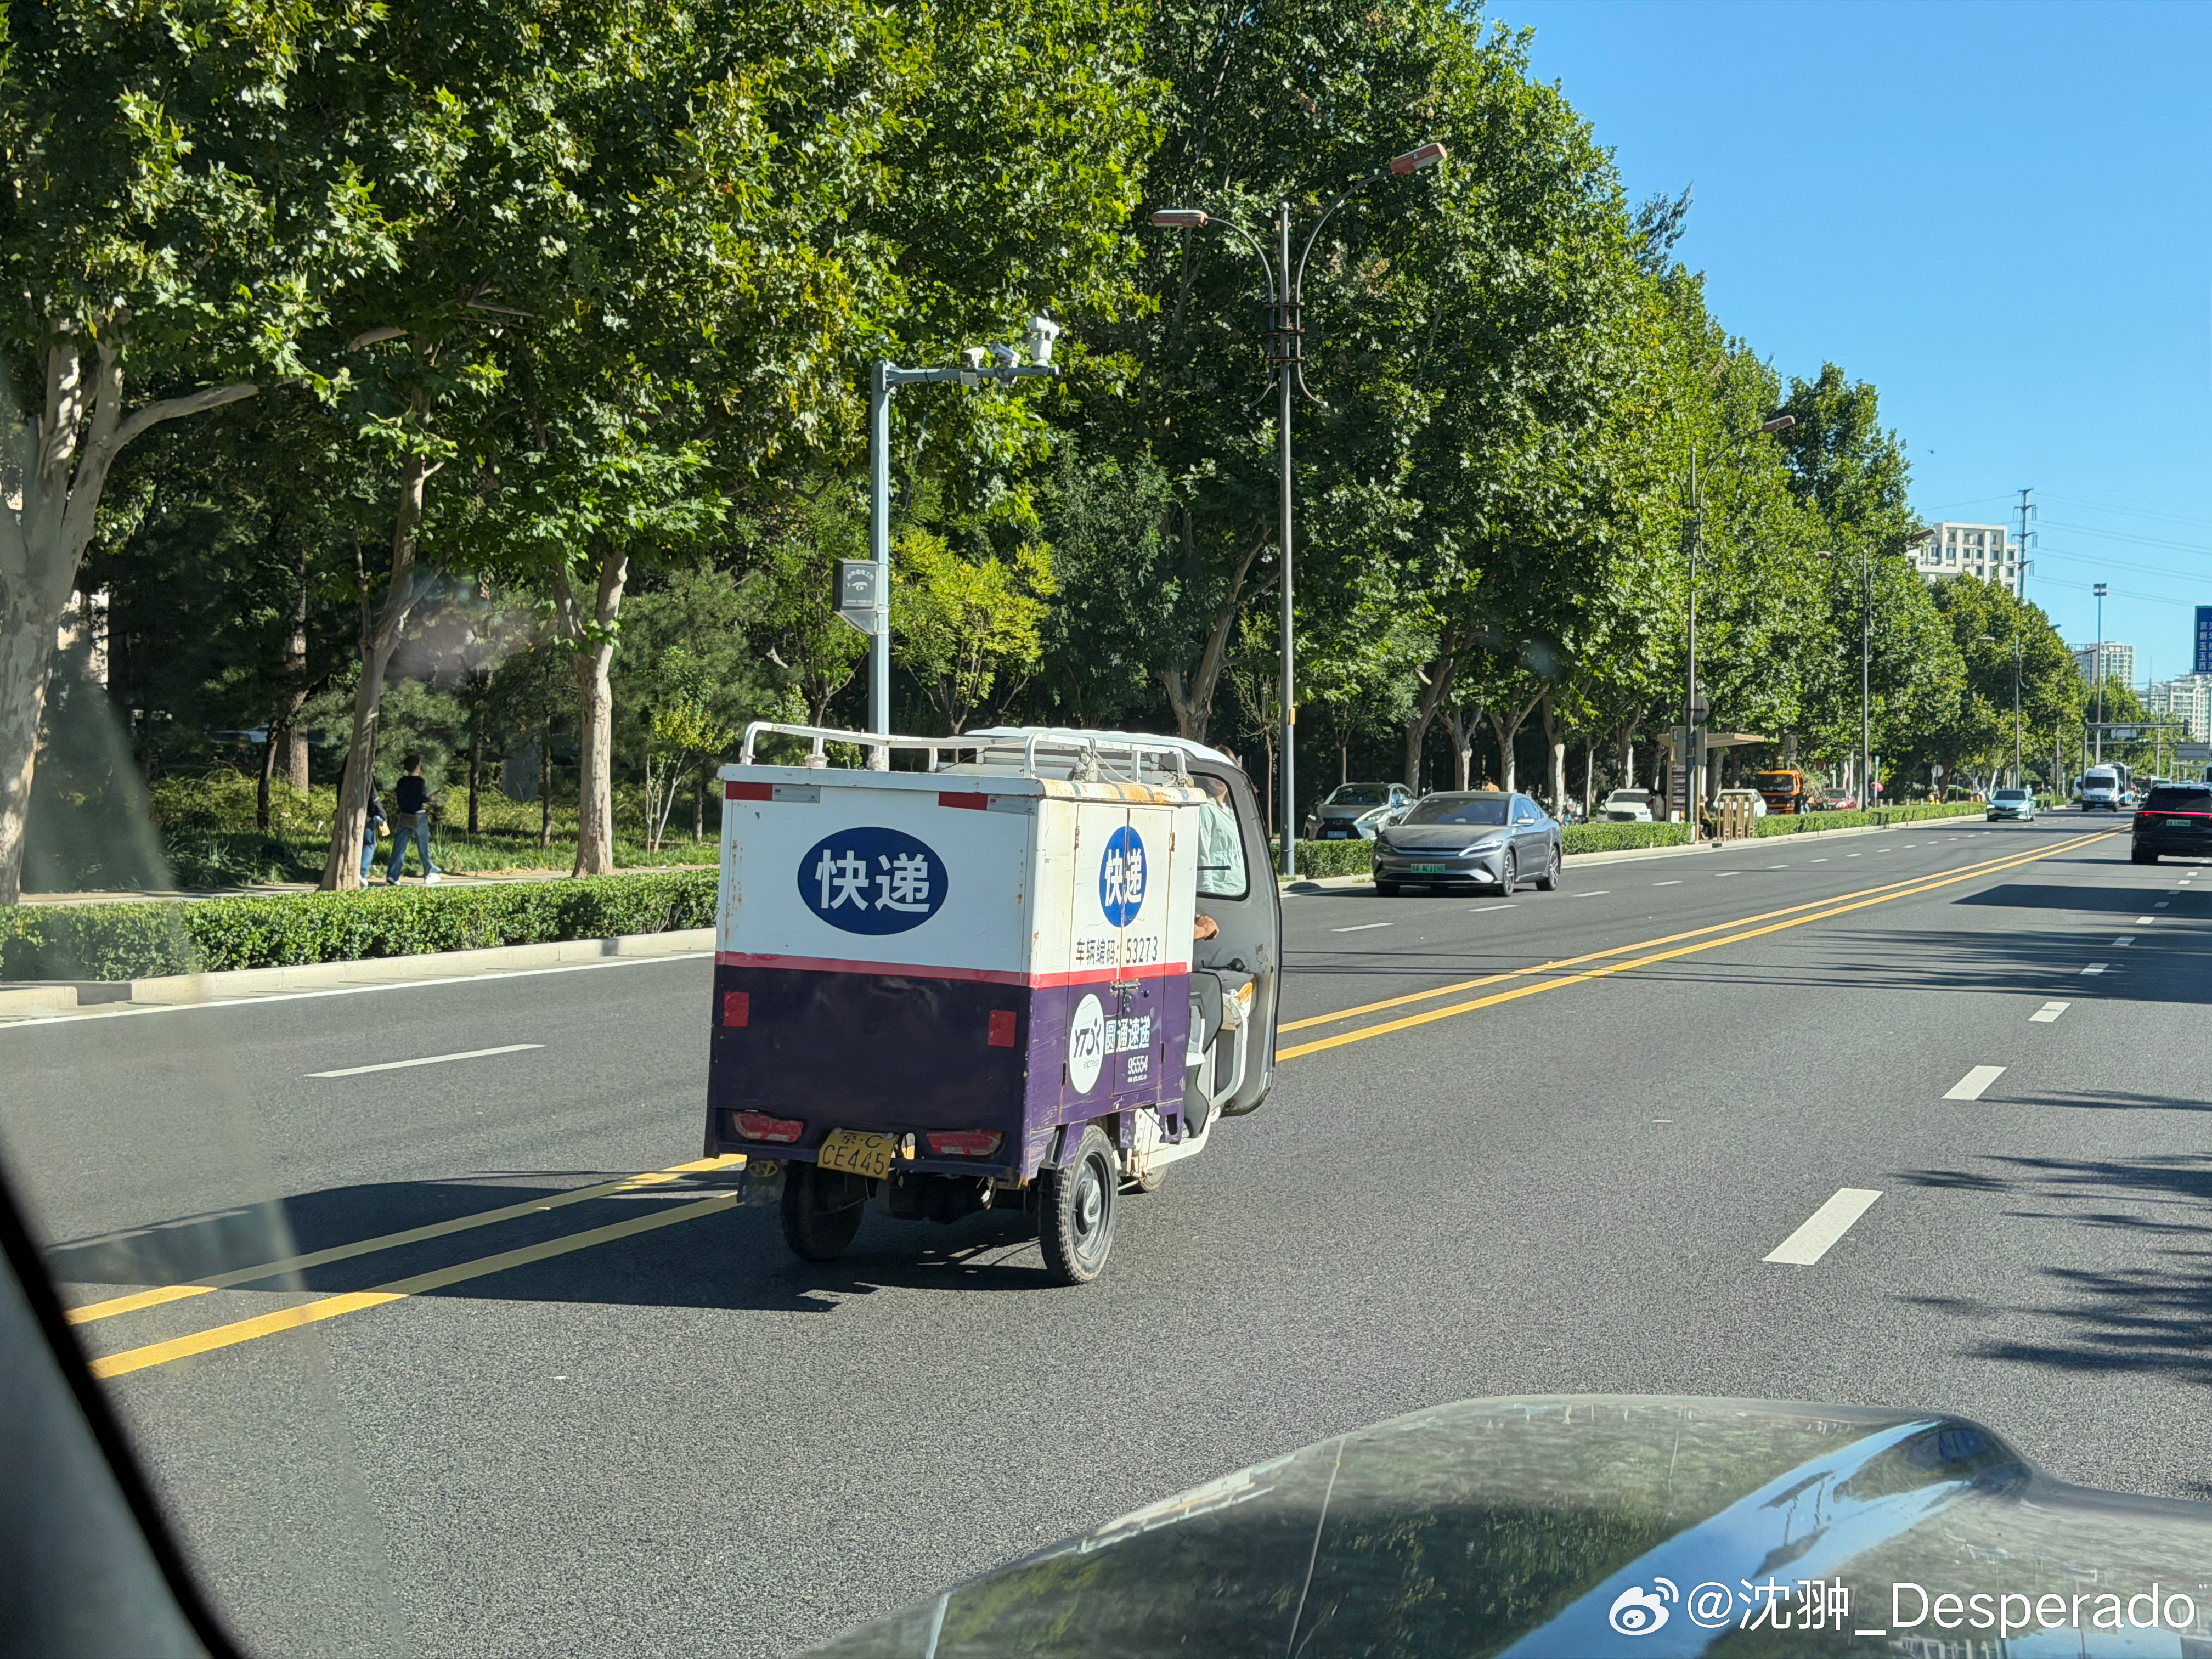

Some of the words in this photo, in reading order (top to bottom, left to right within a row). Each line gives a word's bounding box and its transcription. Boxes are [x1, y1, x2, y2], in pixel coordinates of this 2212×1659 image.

[815, 849, 930, 912] 快递
[1105, 848, 1142, 906] 快递
[1125, 935, 1158, 964] 53273
[1104, 1015, 1150, 1054] 圆通速递
[1127, 1054, 1148, 1075] 95554
